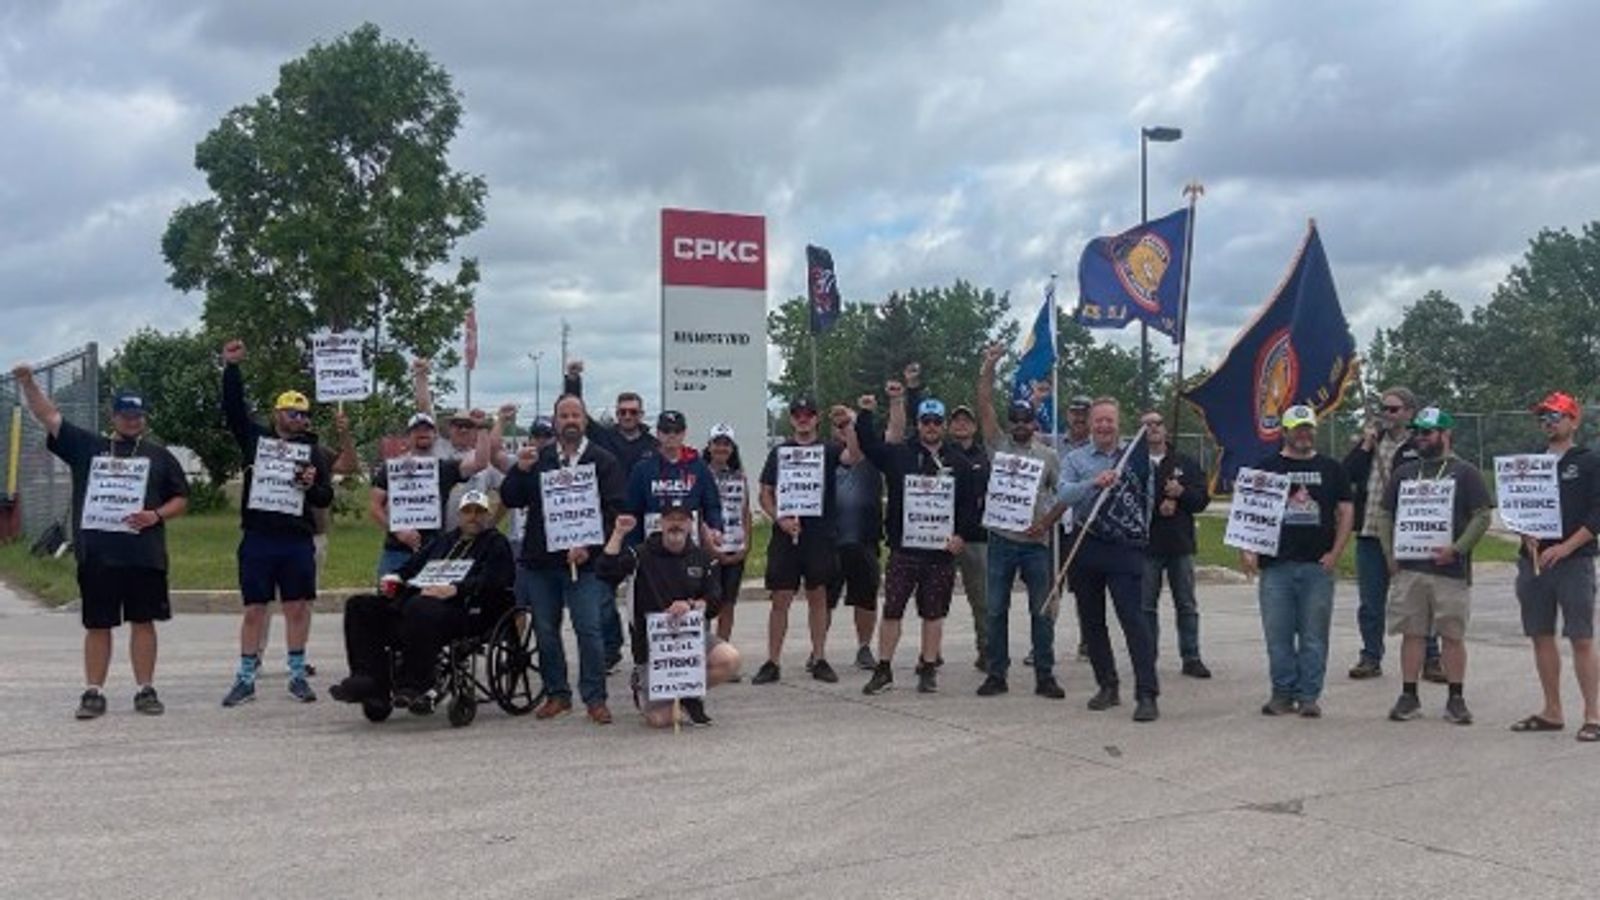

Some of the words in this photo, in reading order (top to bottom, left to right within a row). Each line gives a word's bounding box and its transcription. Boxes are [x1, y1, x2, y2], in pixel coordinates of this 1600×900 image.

[673, 237, 759, 263] CPKC
[1502, 498, 1556, 509] STRIKE
[1399, 520, 1448, 532] STRIKE
